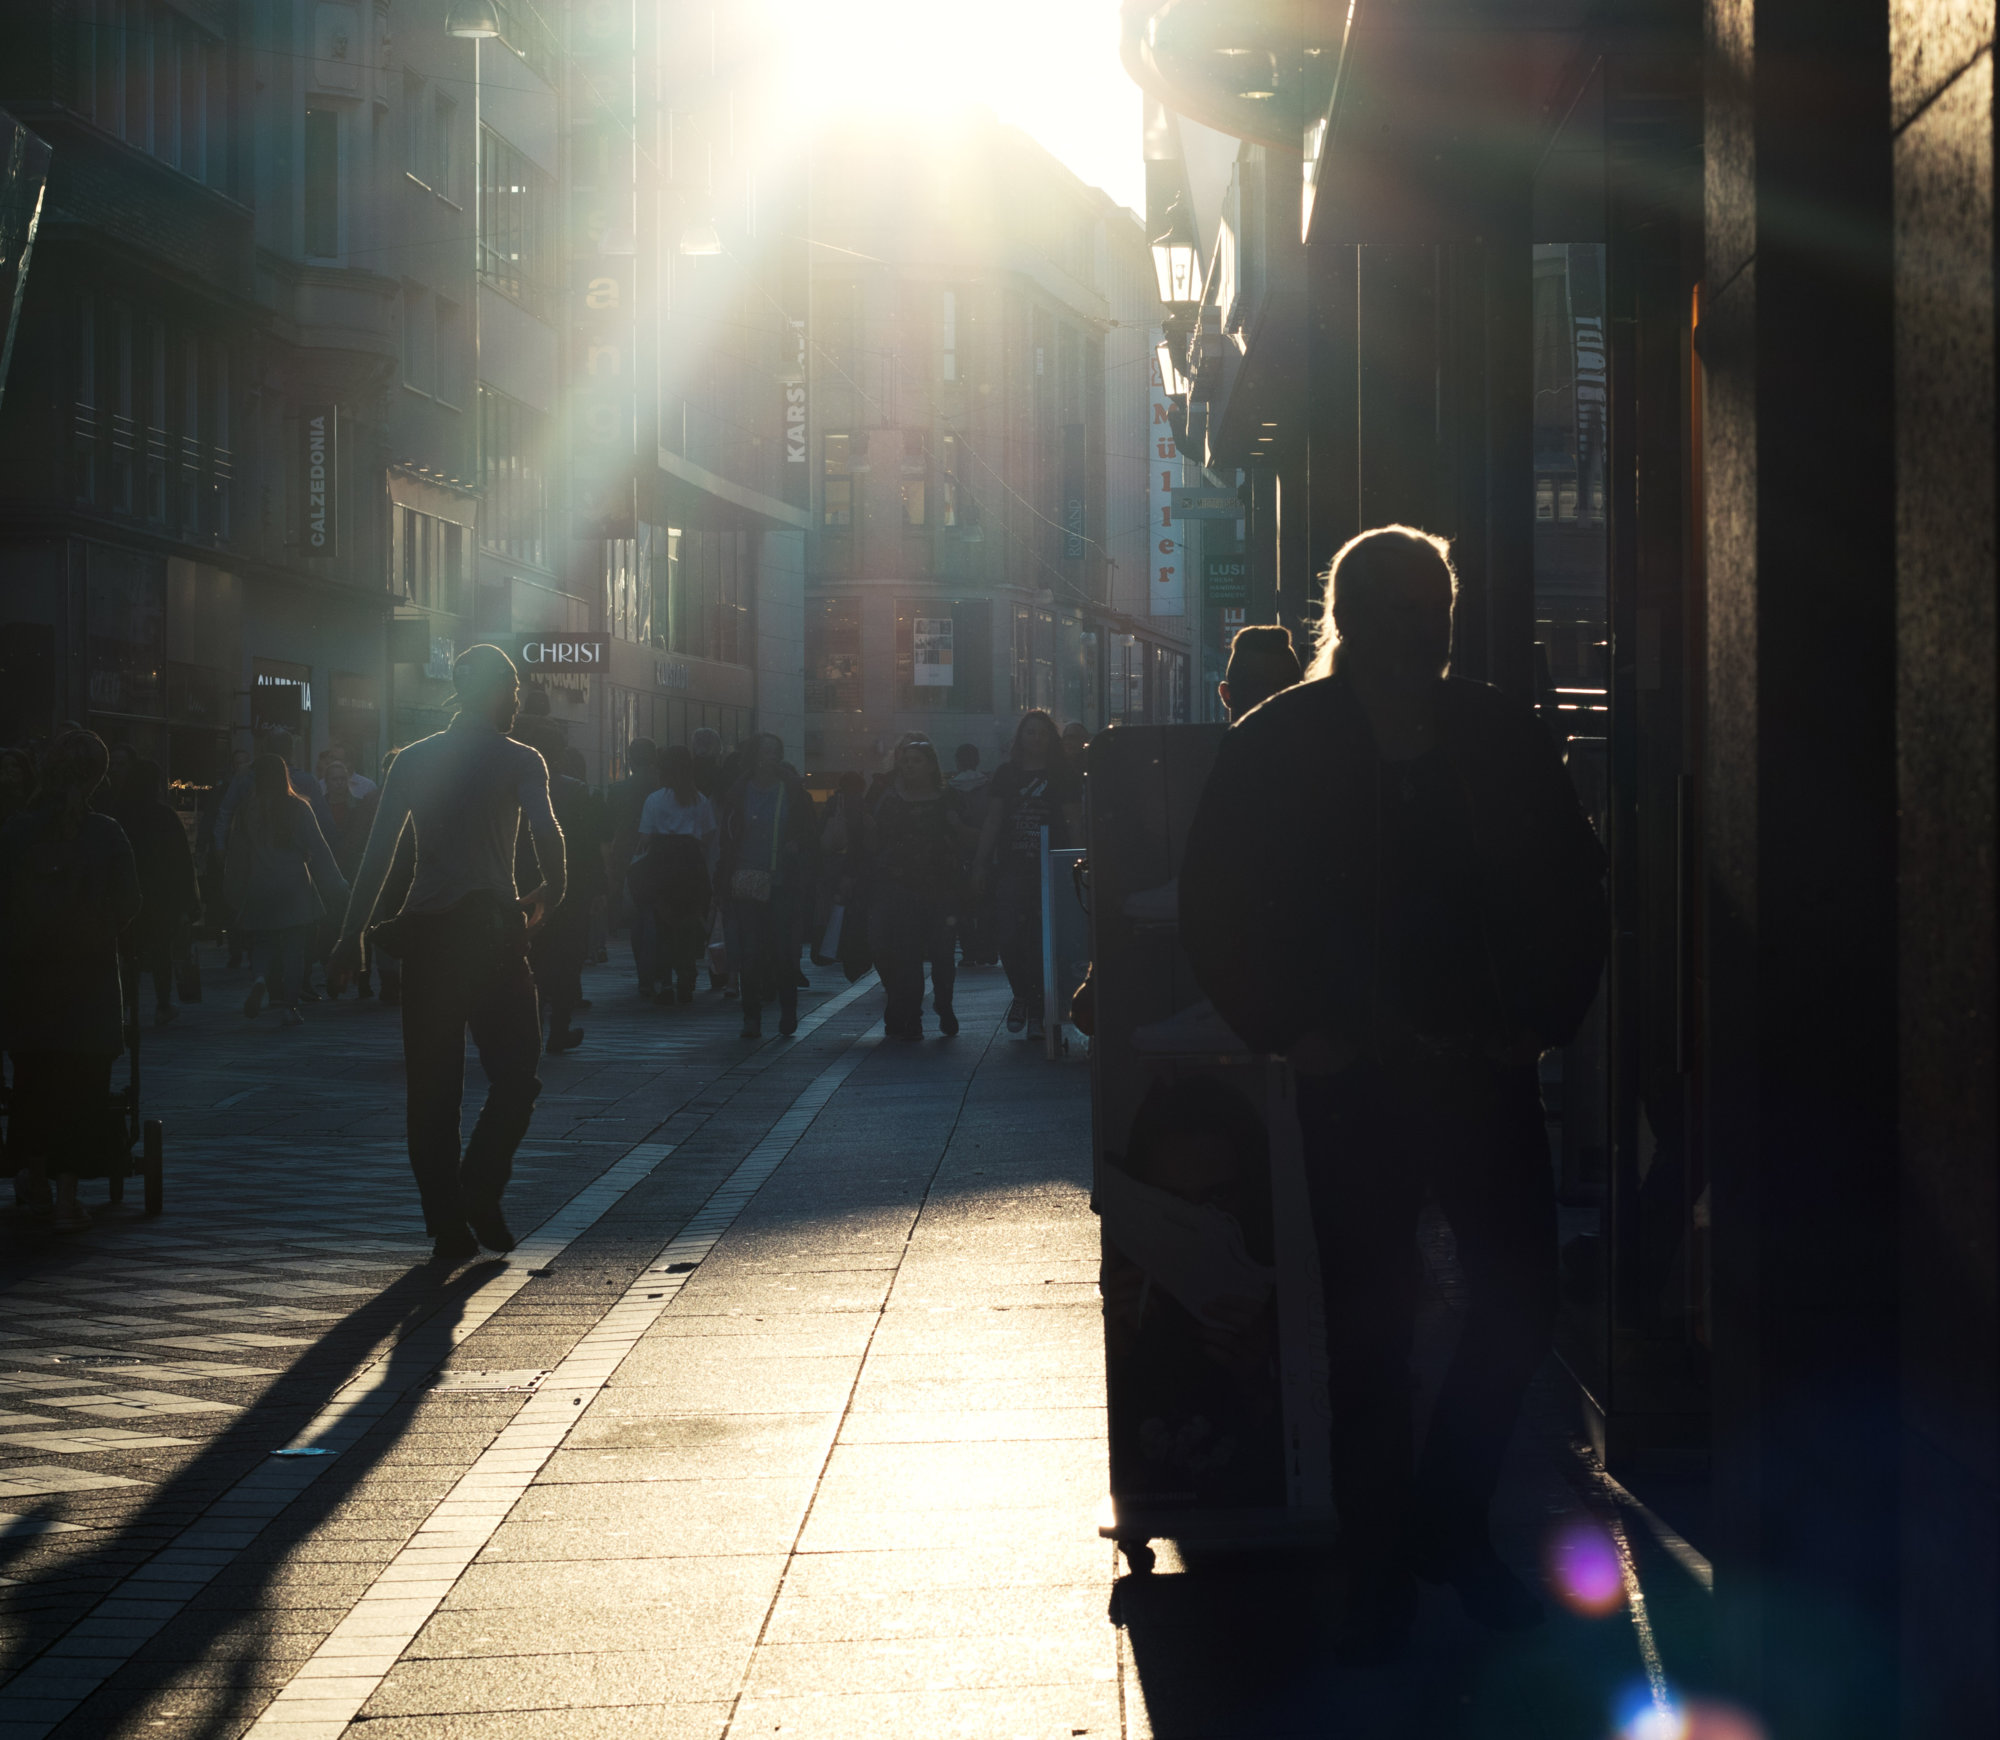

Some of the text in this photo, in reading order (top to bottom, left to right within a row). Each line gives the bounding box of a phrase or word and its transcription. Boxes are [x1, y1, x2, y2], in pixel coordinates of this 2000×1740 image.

[786, 317, 806, 463] KARST
[310, 415, 325, 547] CALZEDONIA
[1153, 403, 1178, 583] Müller
[522, 642, 604, 664] CHRIST
